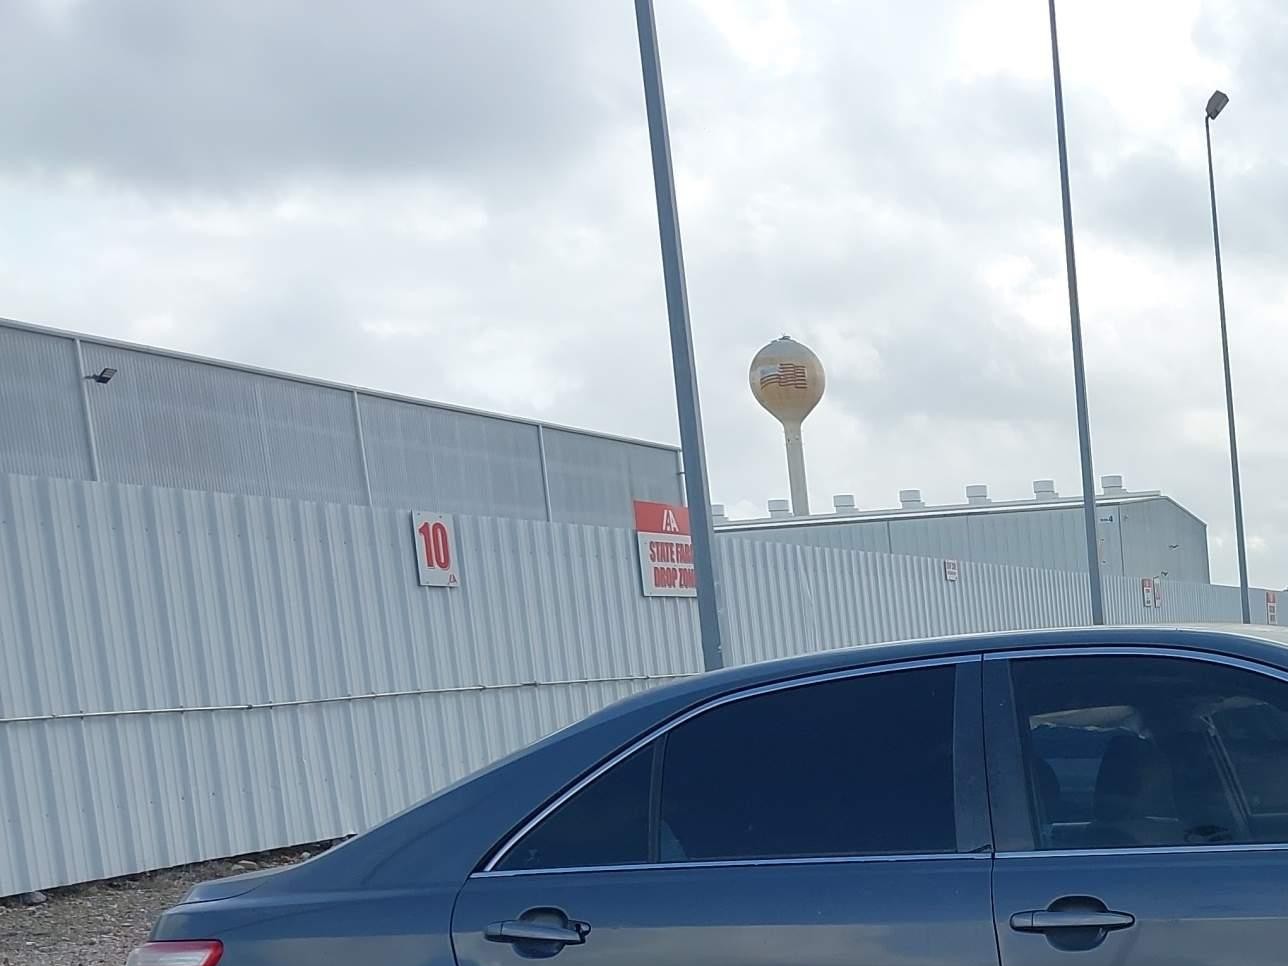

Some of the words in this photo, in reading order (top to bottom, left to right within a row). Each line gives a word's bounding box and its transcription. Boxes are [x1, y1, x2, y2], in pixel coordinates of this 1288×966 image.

[418, 521, 450, 570] 10
[649, 541, 676, 563] STATE
[676, 543, 693, 564] FAR
[654, 567, 678, 588] DROP
